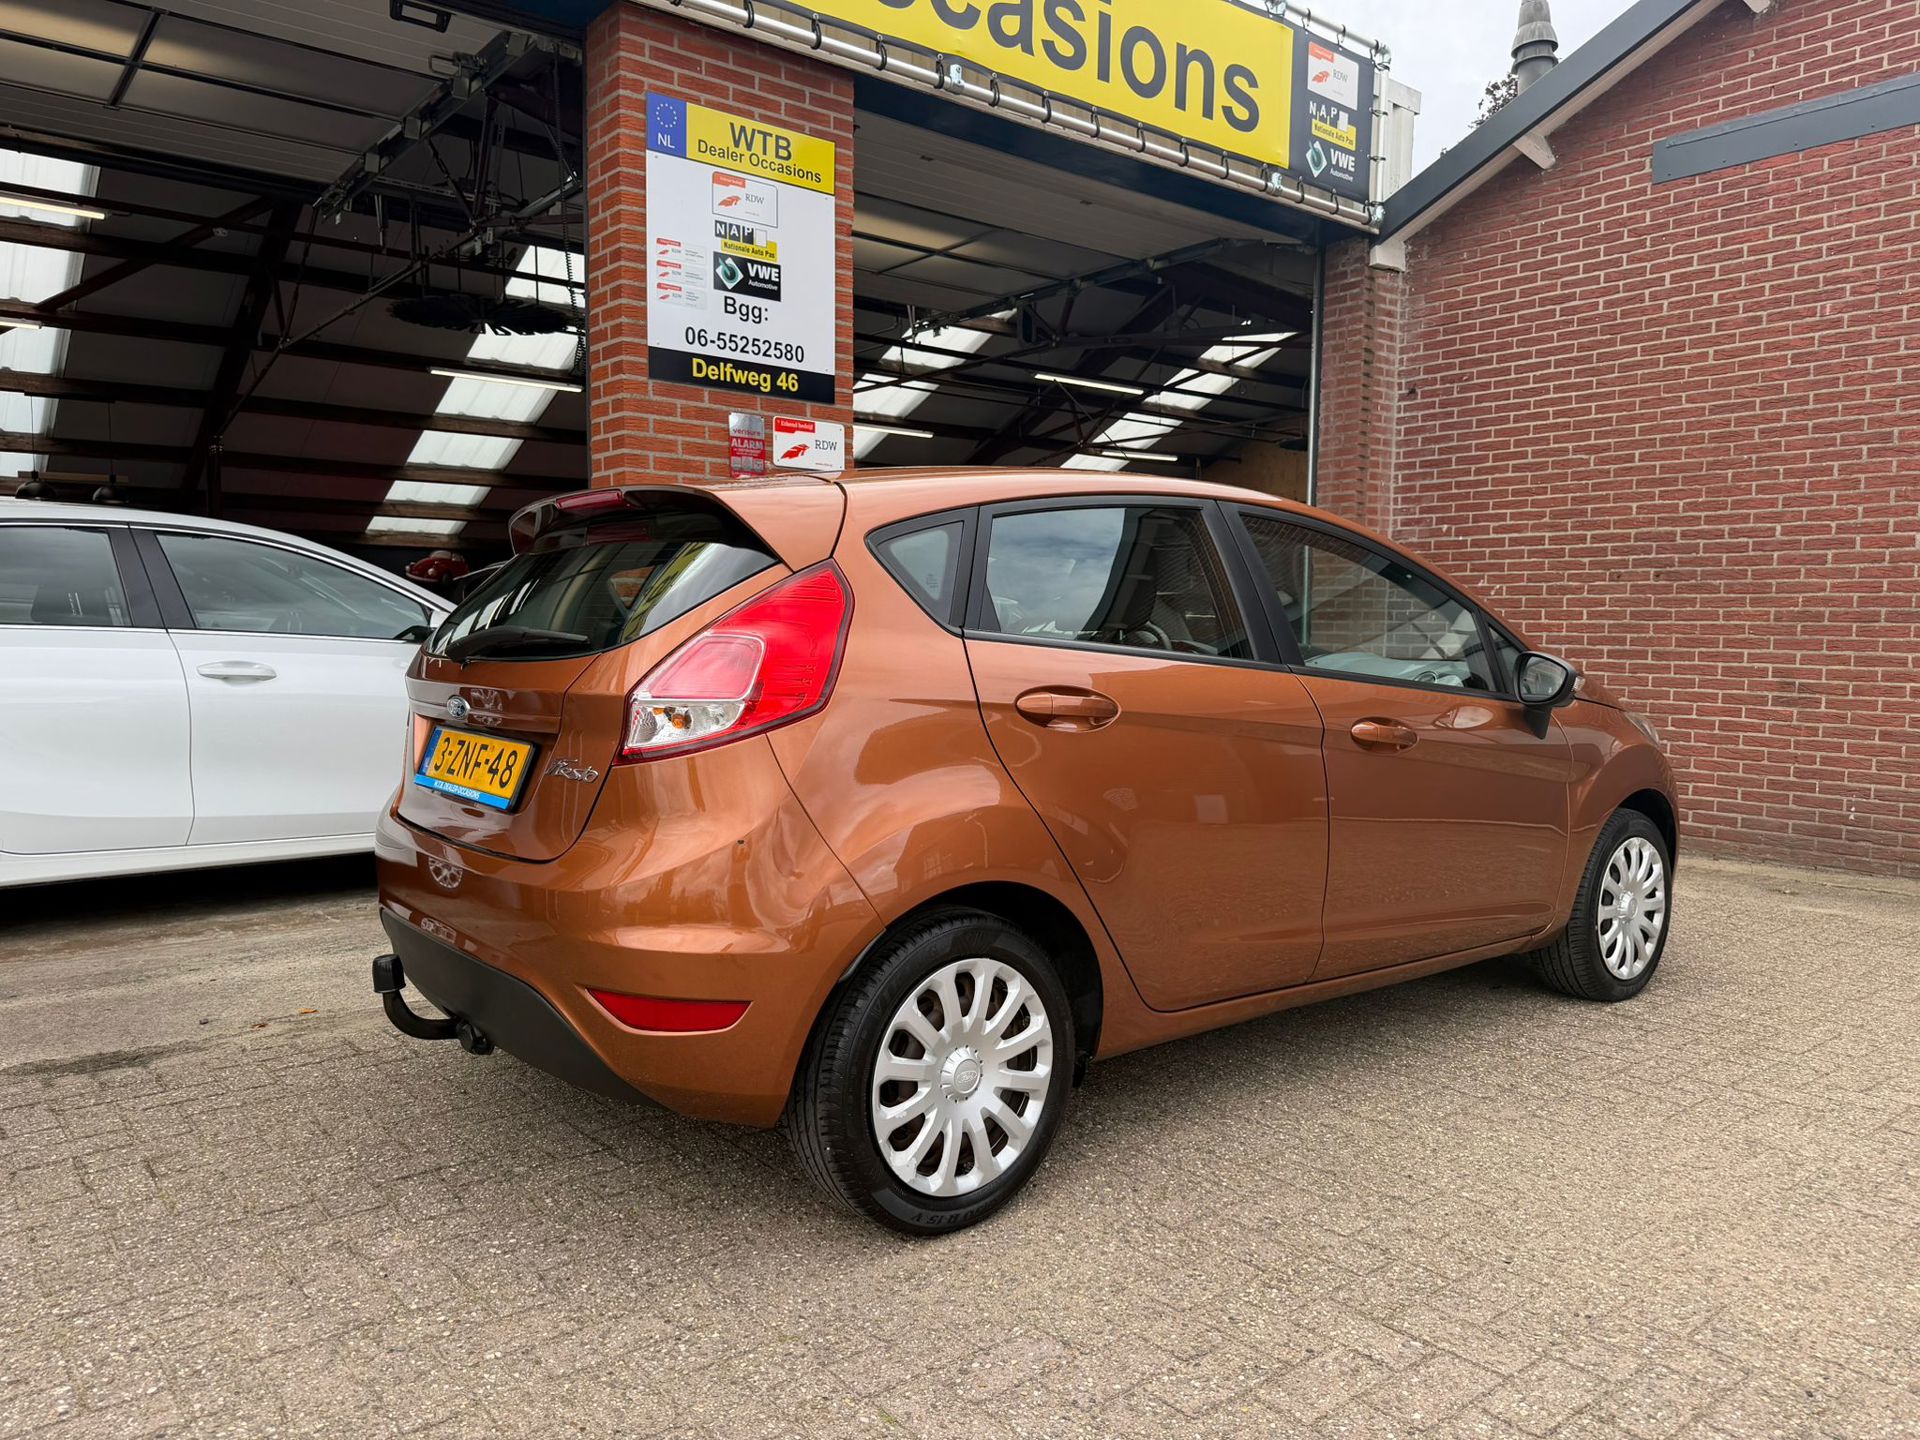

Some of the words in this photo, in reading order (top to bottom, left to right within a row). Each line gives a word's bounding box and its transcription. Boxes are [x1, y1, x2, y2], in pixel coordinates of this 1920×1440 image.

[657, 132, 675, 149] NL
[729, 122, 792, 161] WTB
[1314, 122, 1334, 138] Nationale
[1335, 133, 1345, 142] Auto
[697, 138, 745, 163] Dealer
[749, 152, 822, 184] Occasions
[1330, 148, 1355, 172] VWE
[1329, 167, 1353, 182] Automotive
[745, 192, 765, 205] RDW
[723, 241, 750, 254] Nationale
[751, 247, 764, 256] Auto
[765, 250, 775, 259] Pas
[747, 262, 780, 282] VWE
[748, 279, 778, 291] Automotive
[724, 295, 769, 324] Bgg:
[685, 326, 805, 363] 06-55252580
[692, 357, 772, 392] Delfweg
[777, 371, 799, 392] 46
[731, 438, 763, 450] ALARM
[815, 439, 838, 451] RDW
[433, 736, 518, 789] 3-ZNF-48
